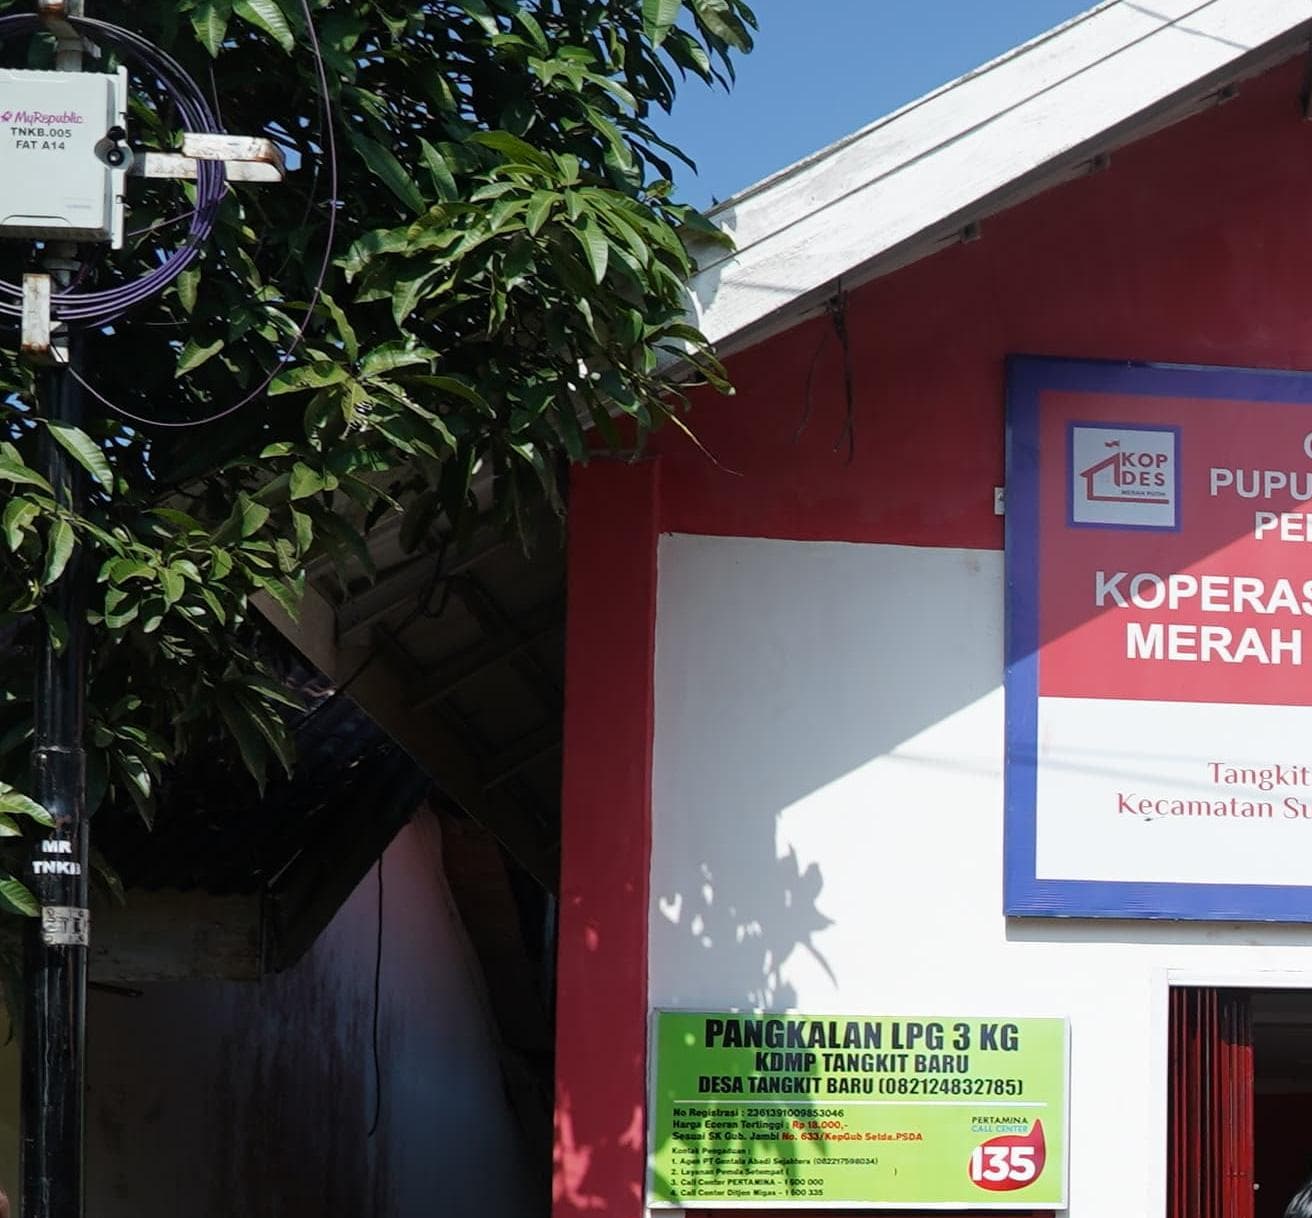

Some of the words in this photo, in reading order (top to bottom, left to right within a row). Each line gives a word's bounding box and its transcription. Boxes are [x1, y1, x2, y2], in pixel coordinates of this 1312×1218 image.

[15, 111, 83, 125] MyRepublic
[11, 127, 72, 138] TNKB.005
[16, 140, 38, 149] FAT
[42, 141, 65, 150] A14
[1121, 452, 1168, 468] KOP
[1121, 471, 1165, 486] DES
[1126, 624, 1301, 665] MERAH
[1208, 762, 1311, 790] Tangkit
[1117, 793, 1273, 819] Kecamatan
[42, 840, 72, 853] MR
[705, 1019, 882, 1049] PANGKALAN
[892, 1022, 944, 1050] LPG
[953, 1023, 970, 1050] 3
[980, 1023, 1019, 1051] KG
[755, 1051, 816, 1072] KDMP
[822, 1053, 909, 1073] TANGKIT
[914, 1054, 969, 1073] BARU
[699, 1076, 744, 1094] DESA
[748, 1076, 822, 1094] TANGKIT
[826, 1077, 873, 1095] BARU
[879, 1078, 1023, 1095] (082124832785)
[673, 1109, 686, 1117] No
[689, 1109, 739, 1118] Registrasi
[972, 1145, 1036, 1181] 135
